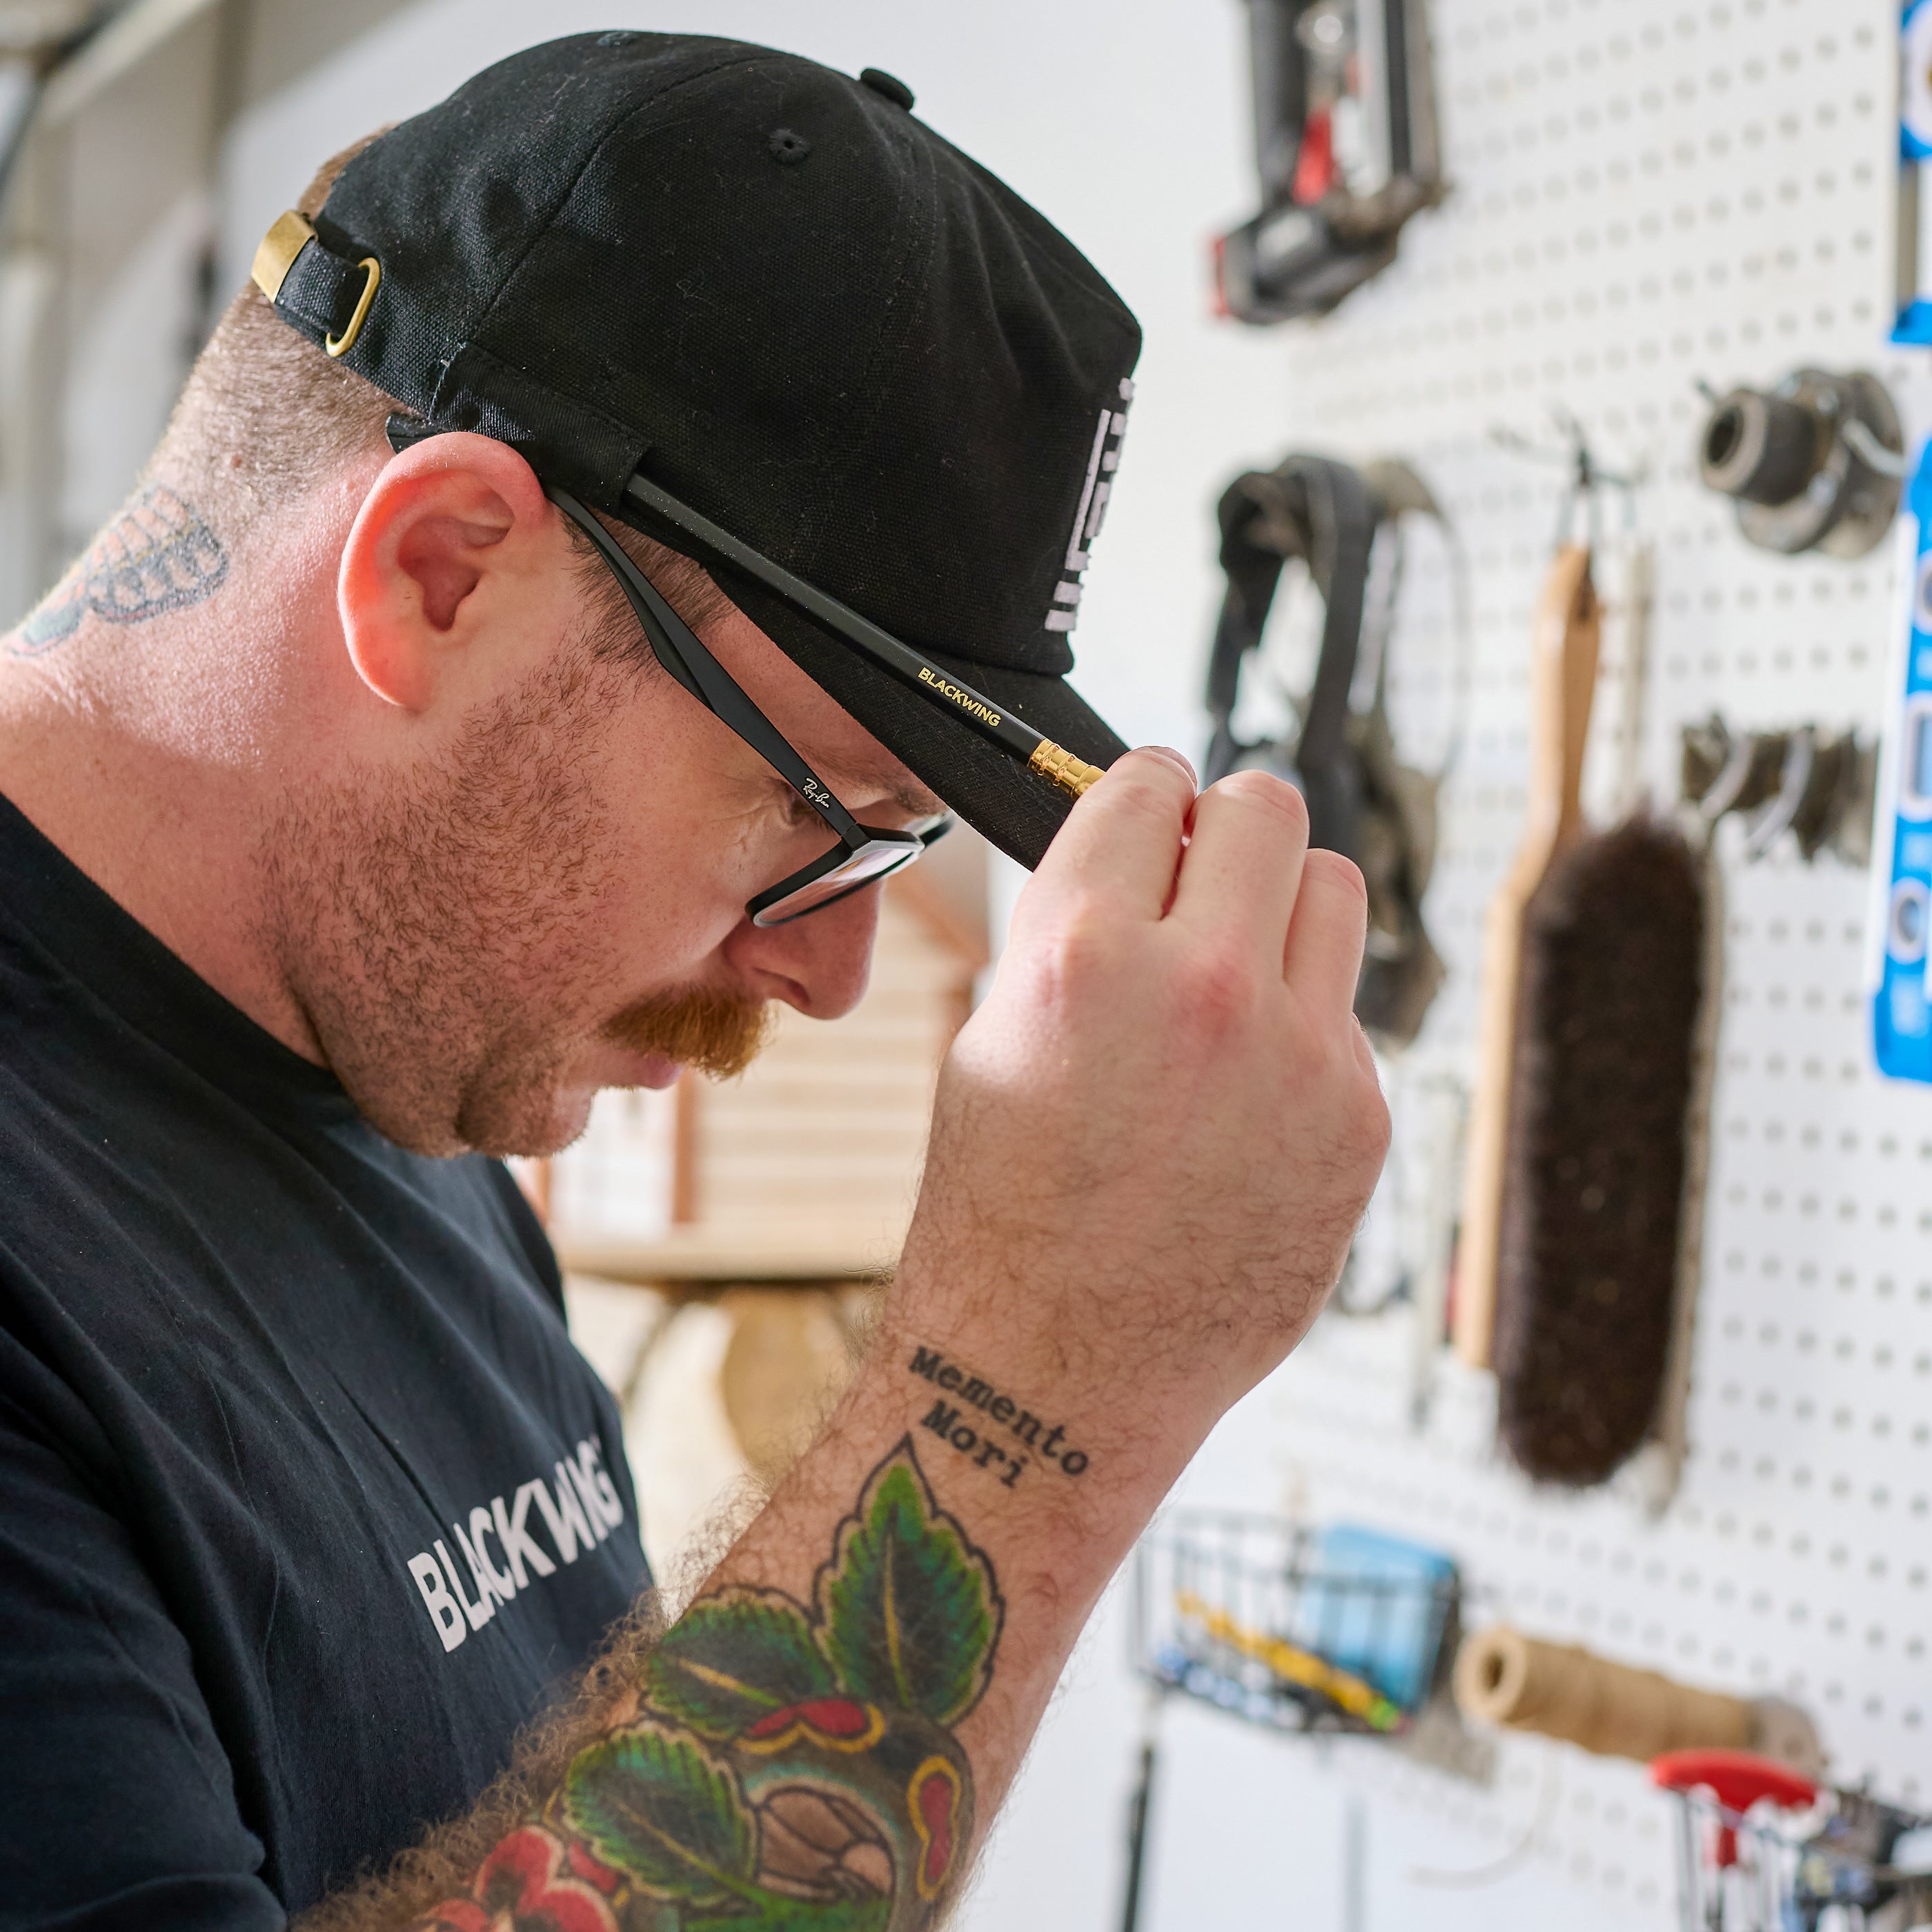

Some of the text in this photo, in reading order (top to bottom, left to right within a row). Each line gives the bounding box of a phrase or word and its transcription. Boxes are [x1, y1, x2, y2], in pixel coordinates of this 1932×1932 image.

[917, 667, 1001, 727] BLACKWING
[909, 1346, 1088, 1476] Memento
[920, 1398, 1028, 1488] Mori
